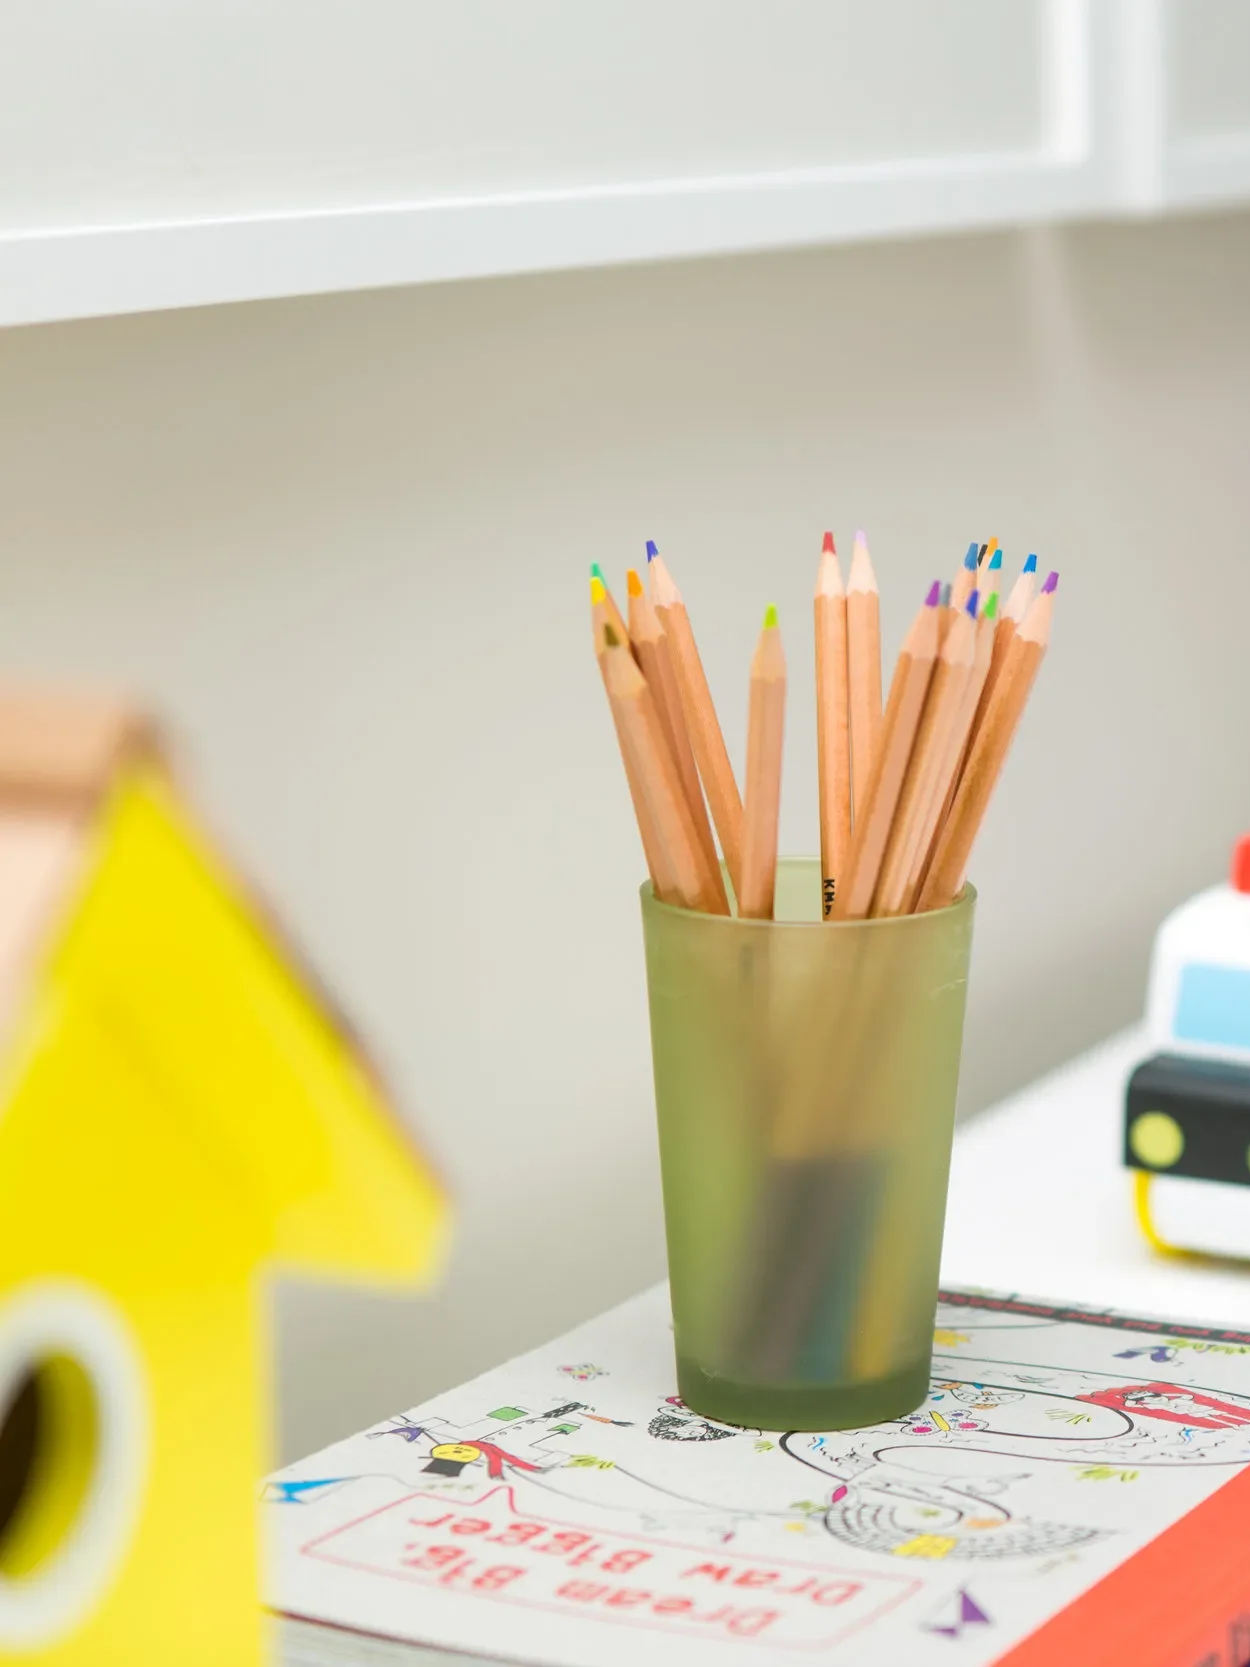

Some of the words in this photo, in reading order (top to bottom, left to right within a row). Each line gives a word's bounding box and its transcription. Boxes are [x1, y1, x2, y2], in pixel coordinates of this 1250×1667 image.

[407, 1512, 655, 1575] Bigger
[555, 1578, 781, 1638] Dream
[679, 1563, 865, 1607] Draw
